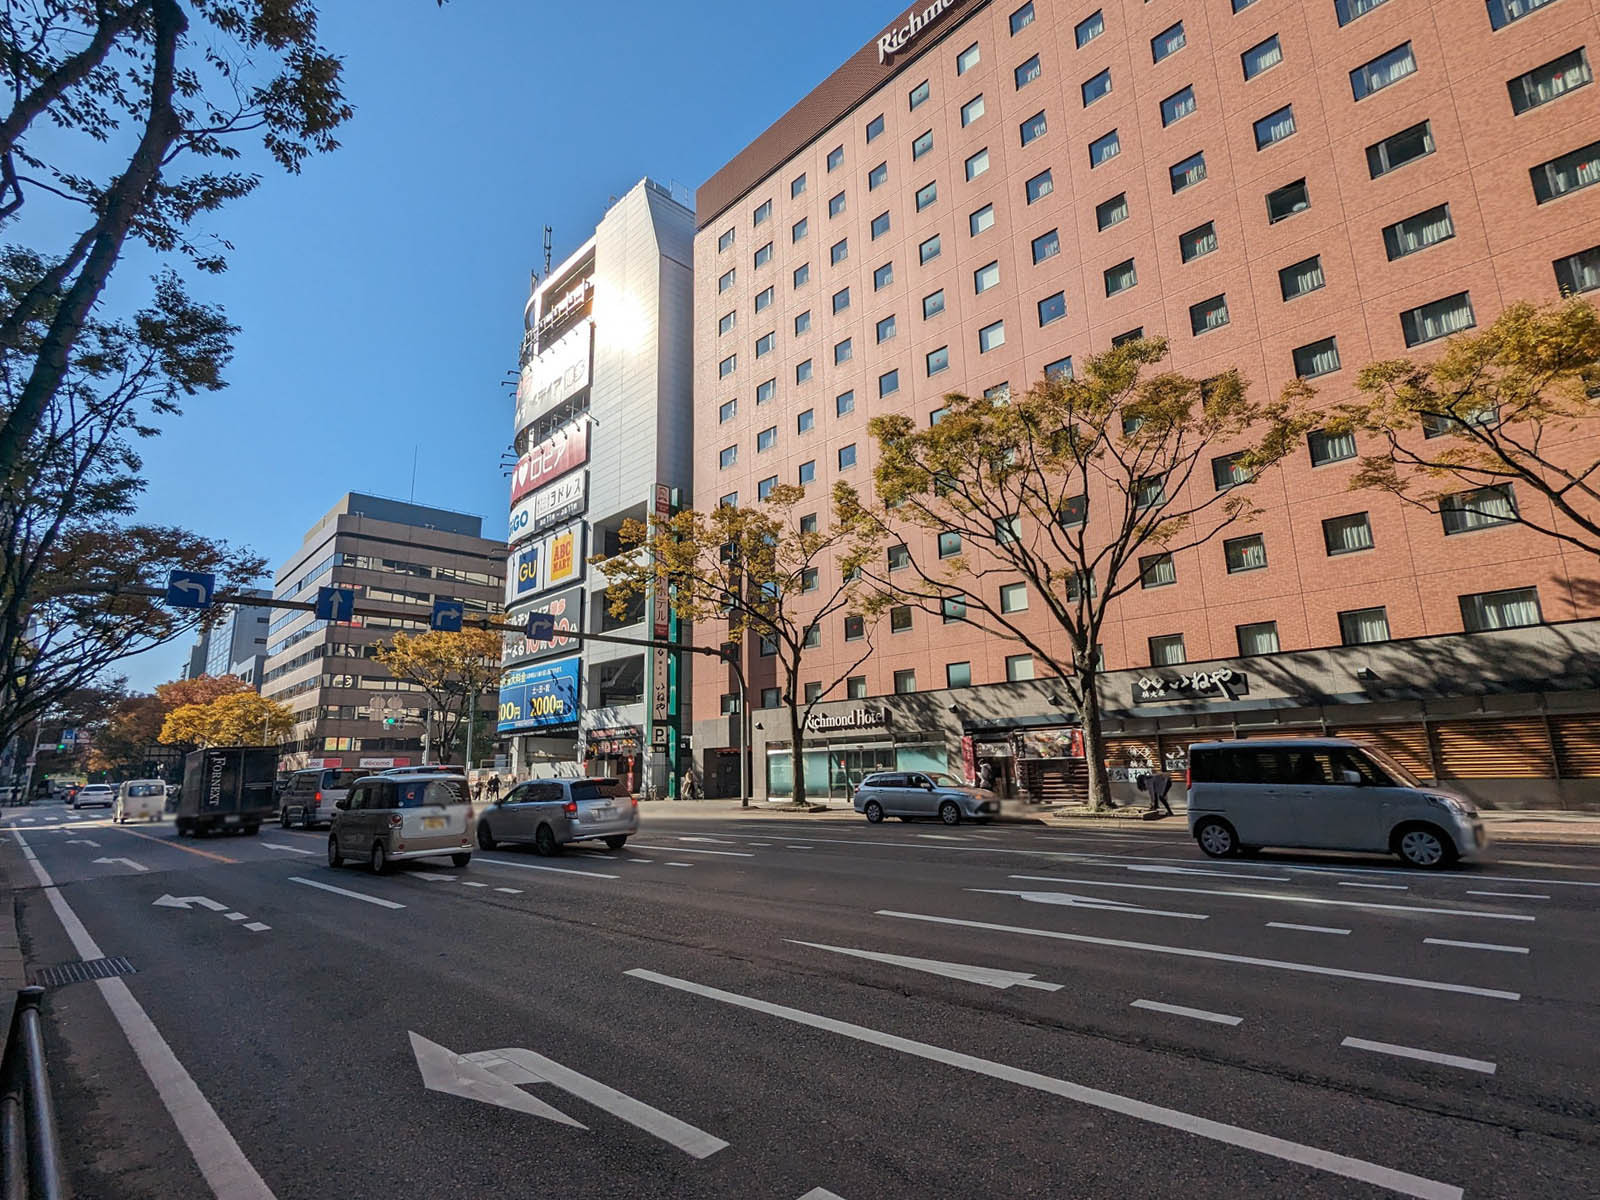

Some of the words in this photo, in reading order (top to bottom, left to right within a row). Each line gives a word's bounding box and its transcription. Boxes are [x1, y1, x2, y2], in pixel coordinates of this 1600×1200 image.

[530, 438, 567, 481] ロピア
[553, 540, 572, 561] ABC
[519, 559, 537, 582] GU
[552, 556, 572, 573] MART
[1169, 667, 1233, 699] いねや
[530, 694, 564, 717] 2000円
[857, 707, 885, 724] Hotel
[655, 728, 665, 741] P
